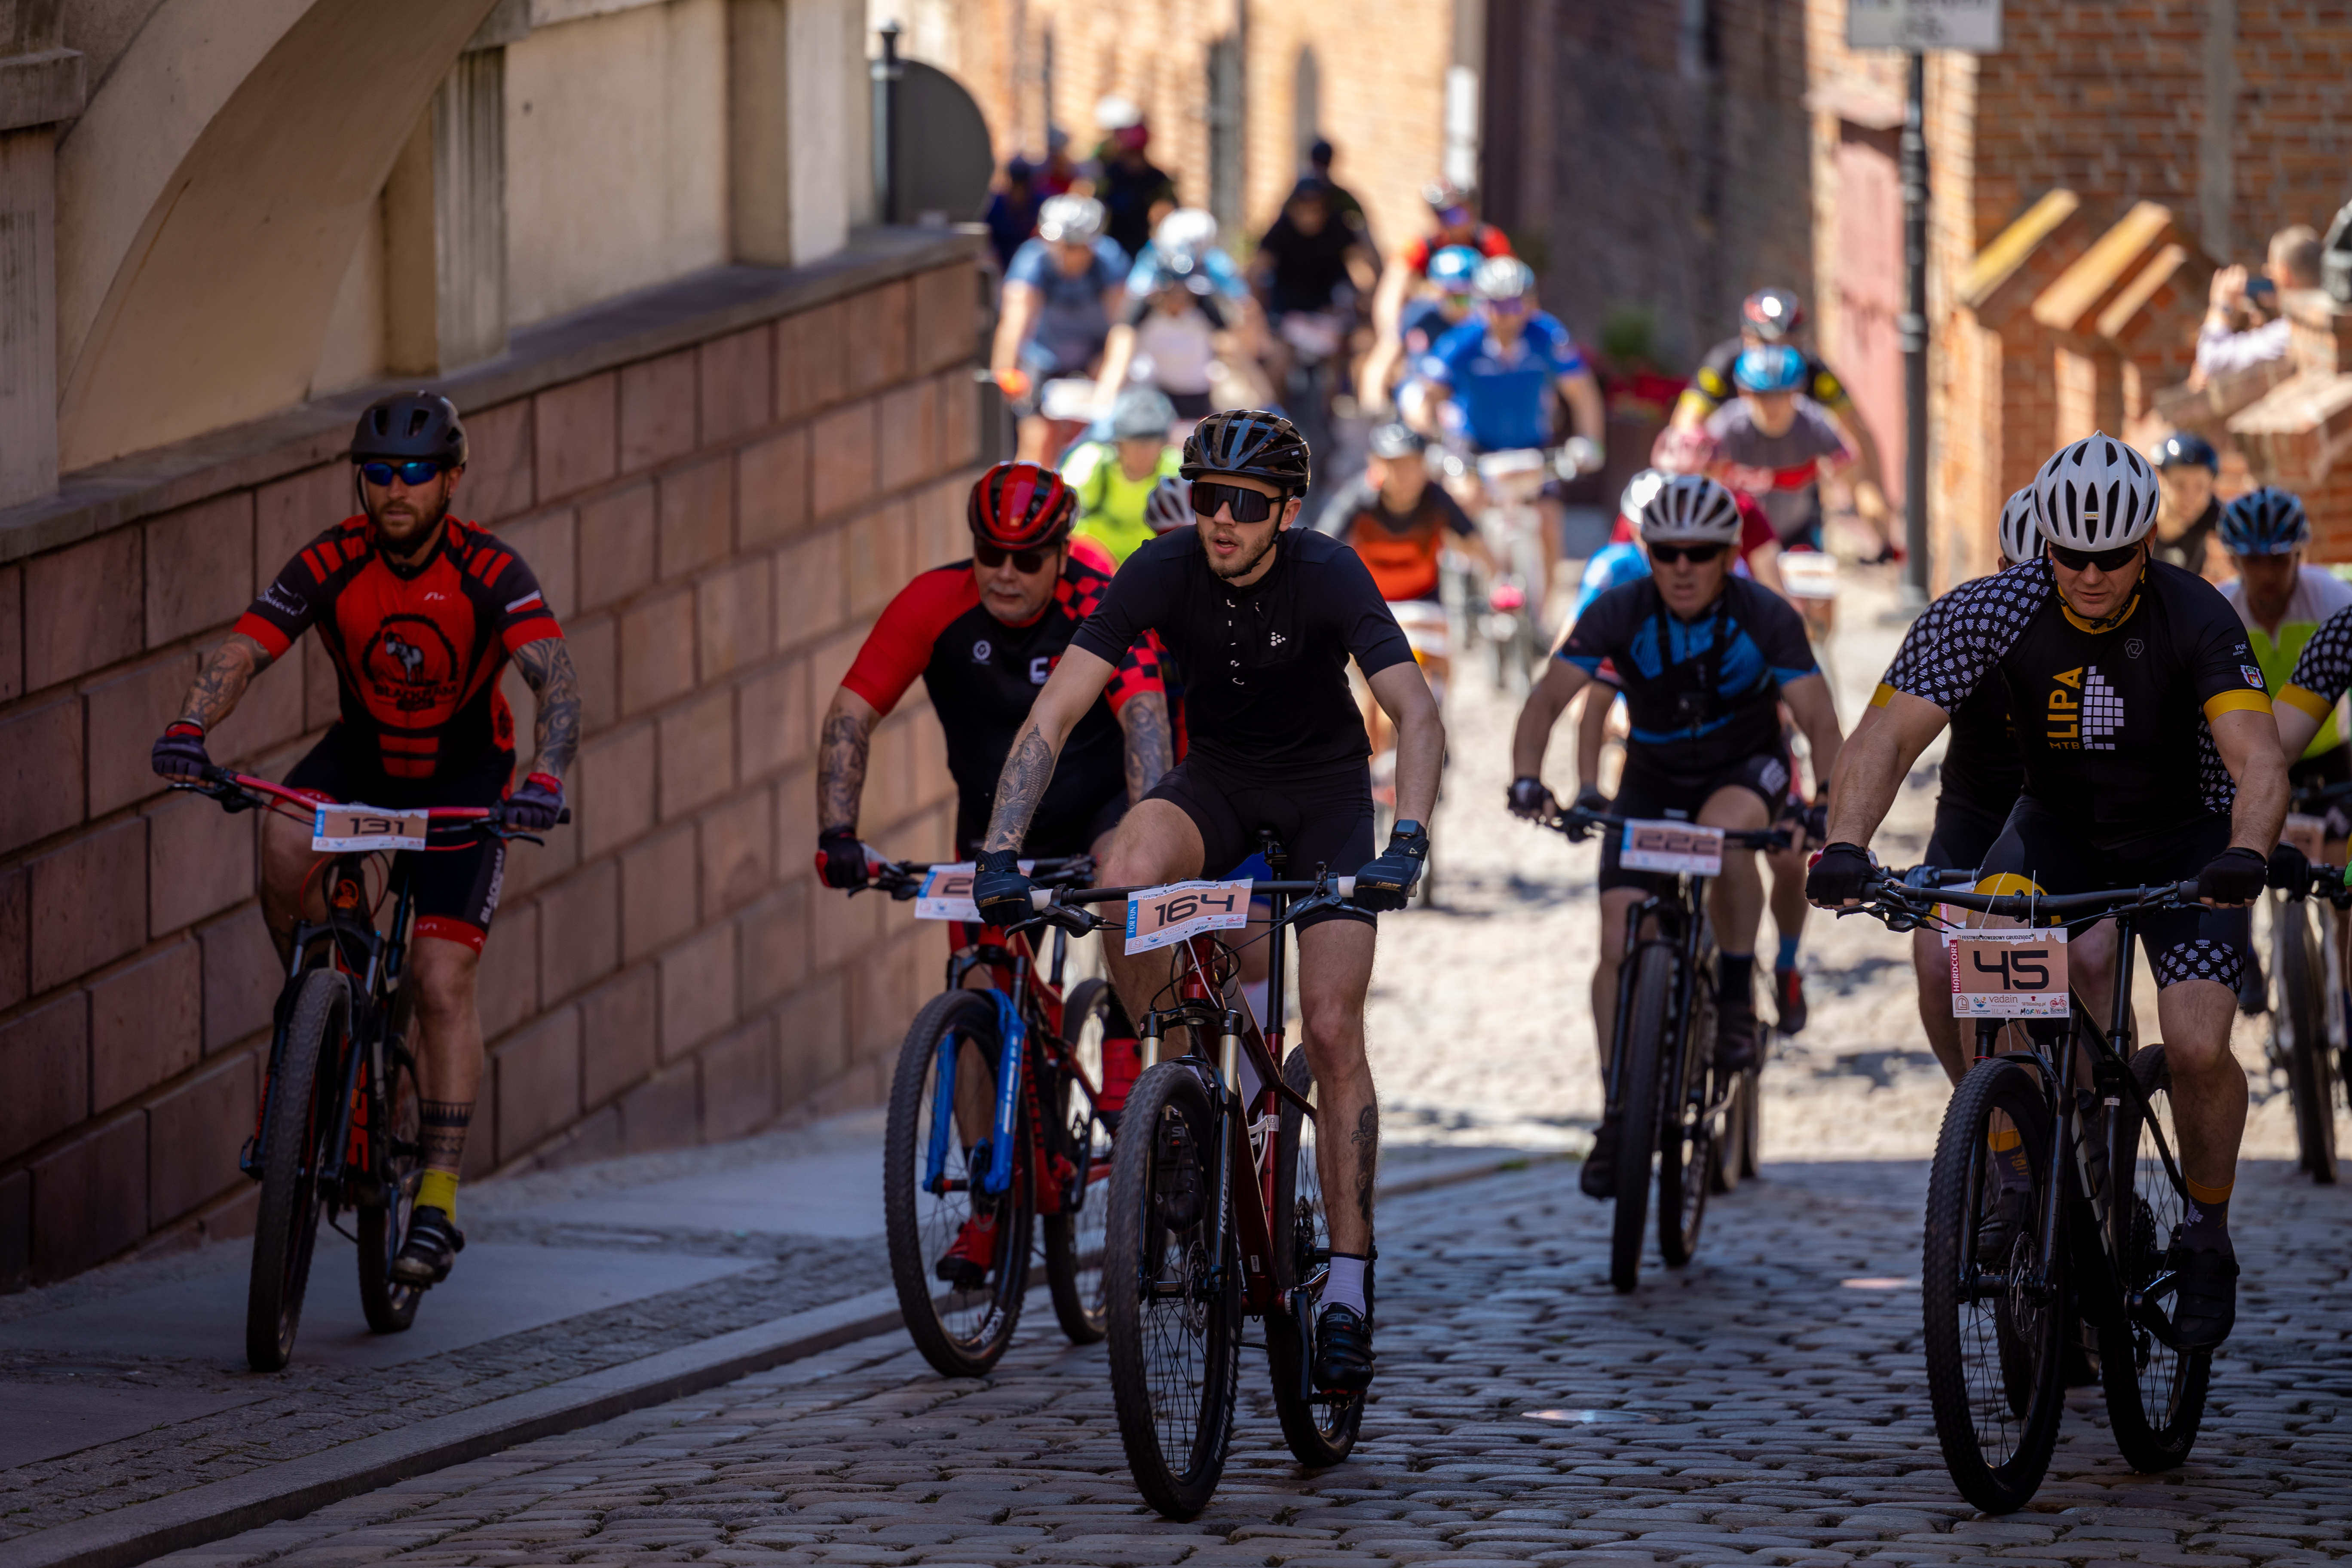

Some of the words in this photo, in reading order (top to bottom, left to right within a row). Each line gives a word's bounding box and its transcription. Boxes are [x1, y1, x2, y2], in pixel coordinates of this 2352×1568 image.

[2047, 667, 2082, 738] LIPA
[350, 818, 404, 835] 131
[1155, 894, 1235, 927] 164
[1951, 942, 1960, 992] HARDCORE
[1973, 950, 2049, 990] 45
[1989, 995, 2018, 1003] vadain
[1326, 1313, 1353, 1324] SIDI
